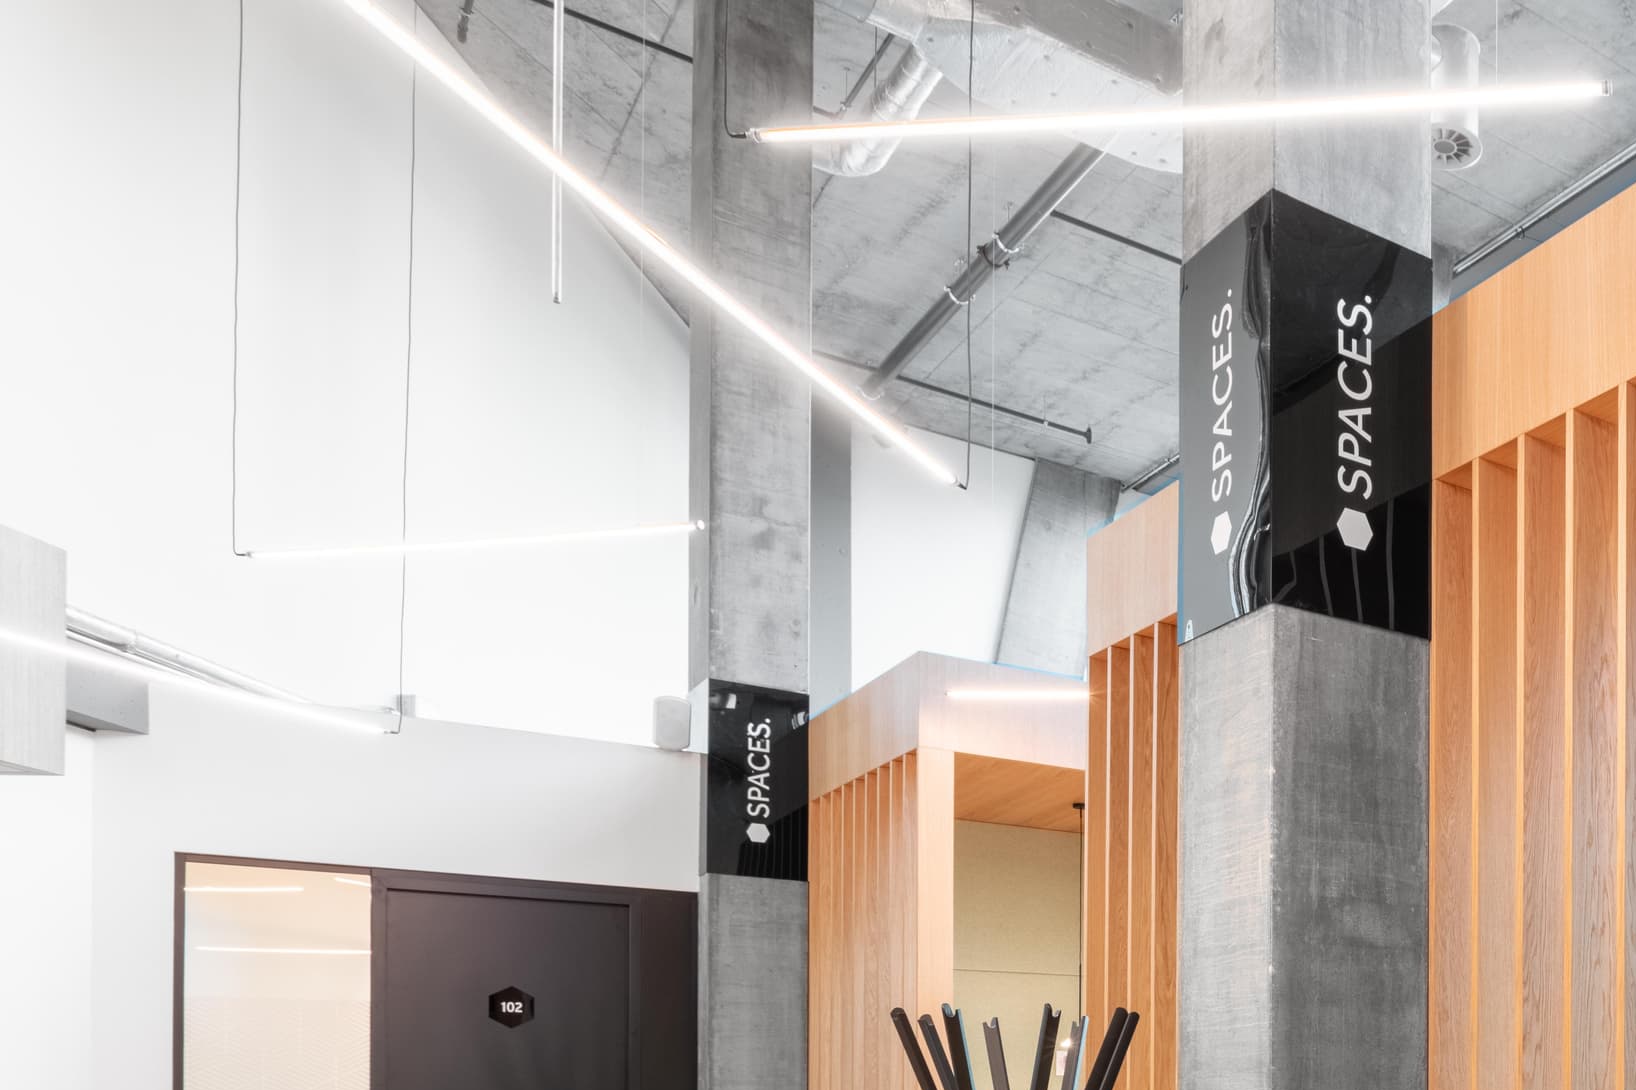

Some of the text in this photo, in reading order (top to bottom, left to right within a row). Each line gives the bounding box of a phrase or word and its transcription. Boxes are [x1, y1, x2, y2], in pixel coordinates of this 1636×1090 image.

[1211, 288, 1233, 502] SPACES.
[1337, 295, 1373, 500] SPACES.
[747, 718, 771, 818] SPACES.
[500, 1001, 523, 1013] 102
